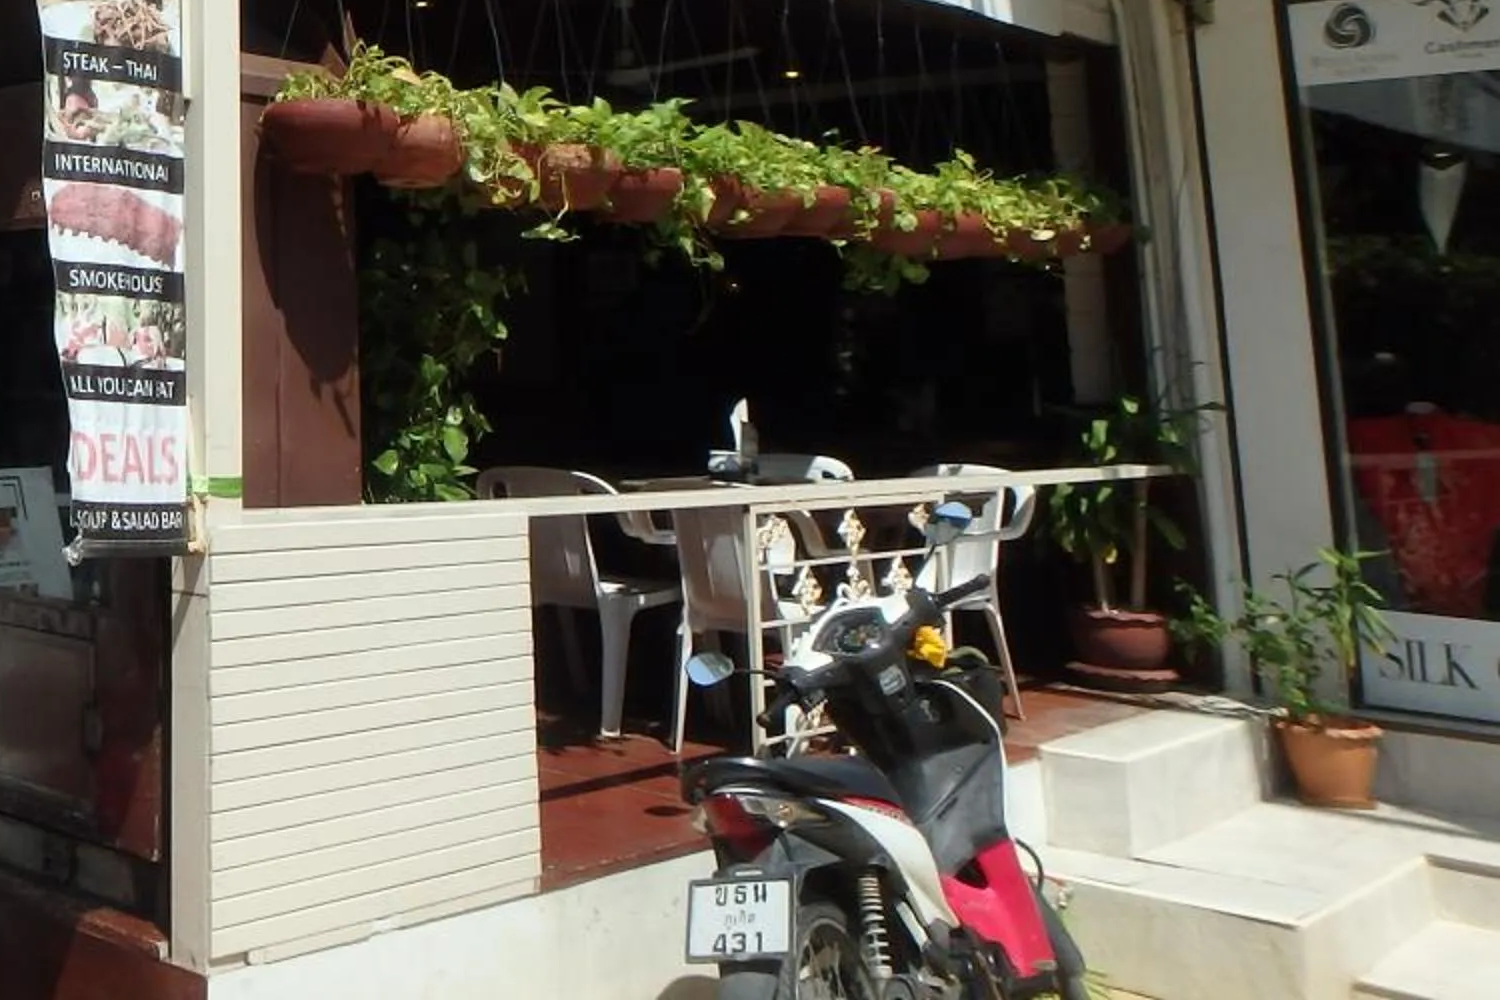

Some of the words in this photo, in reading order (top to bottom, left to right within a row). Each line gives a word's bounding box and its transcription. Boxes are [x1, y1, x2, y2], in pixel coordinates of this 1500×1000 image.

[63, 52, 108, 74] STEAK
[126, 60, 157, 81] THAI
[71, 430, 179, 486] DEALS
[122, 511, 159, 530] SALAD
[161, 511, 182, 530] BAR
[713, 931, 762, 953] 431
